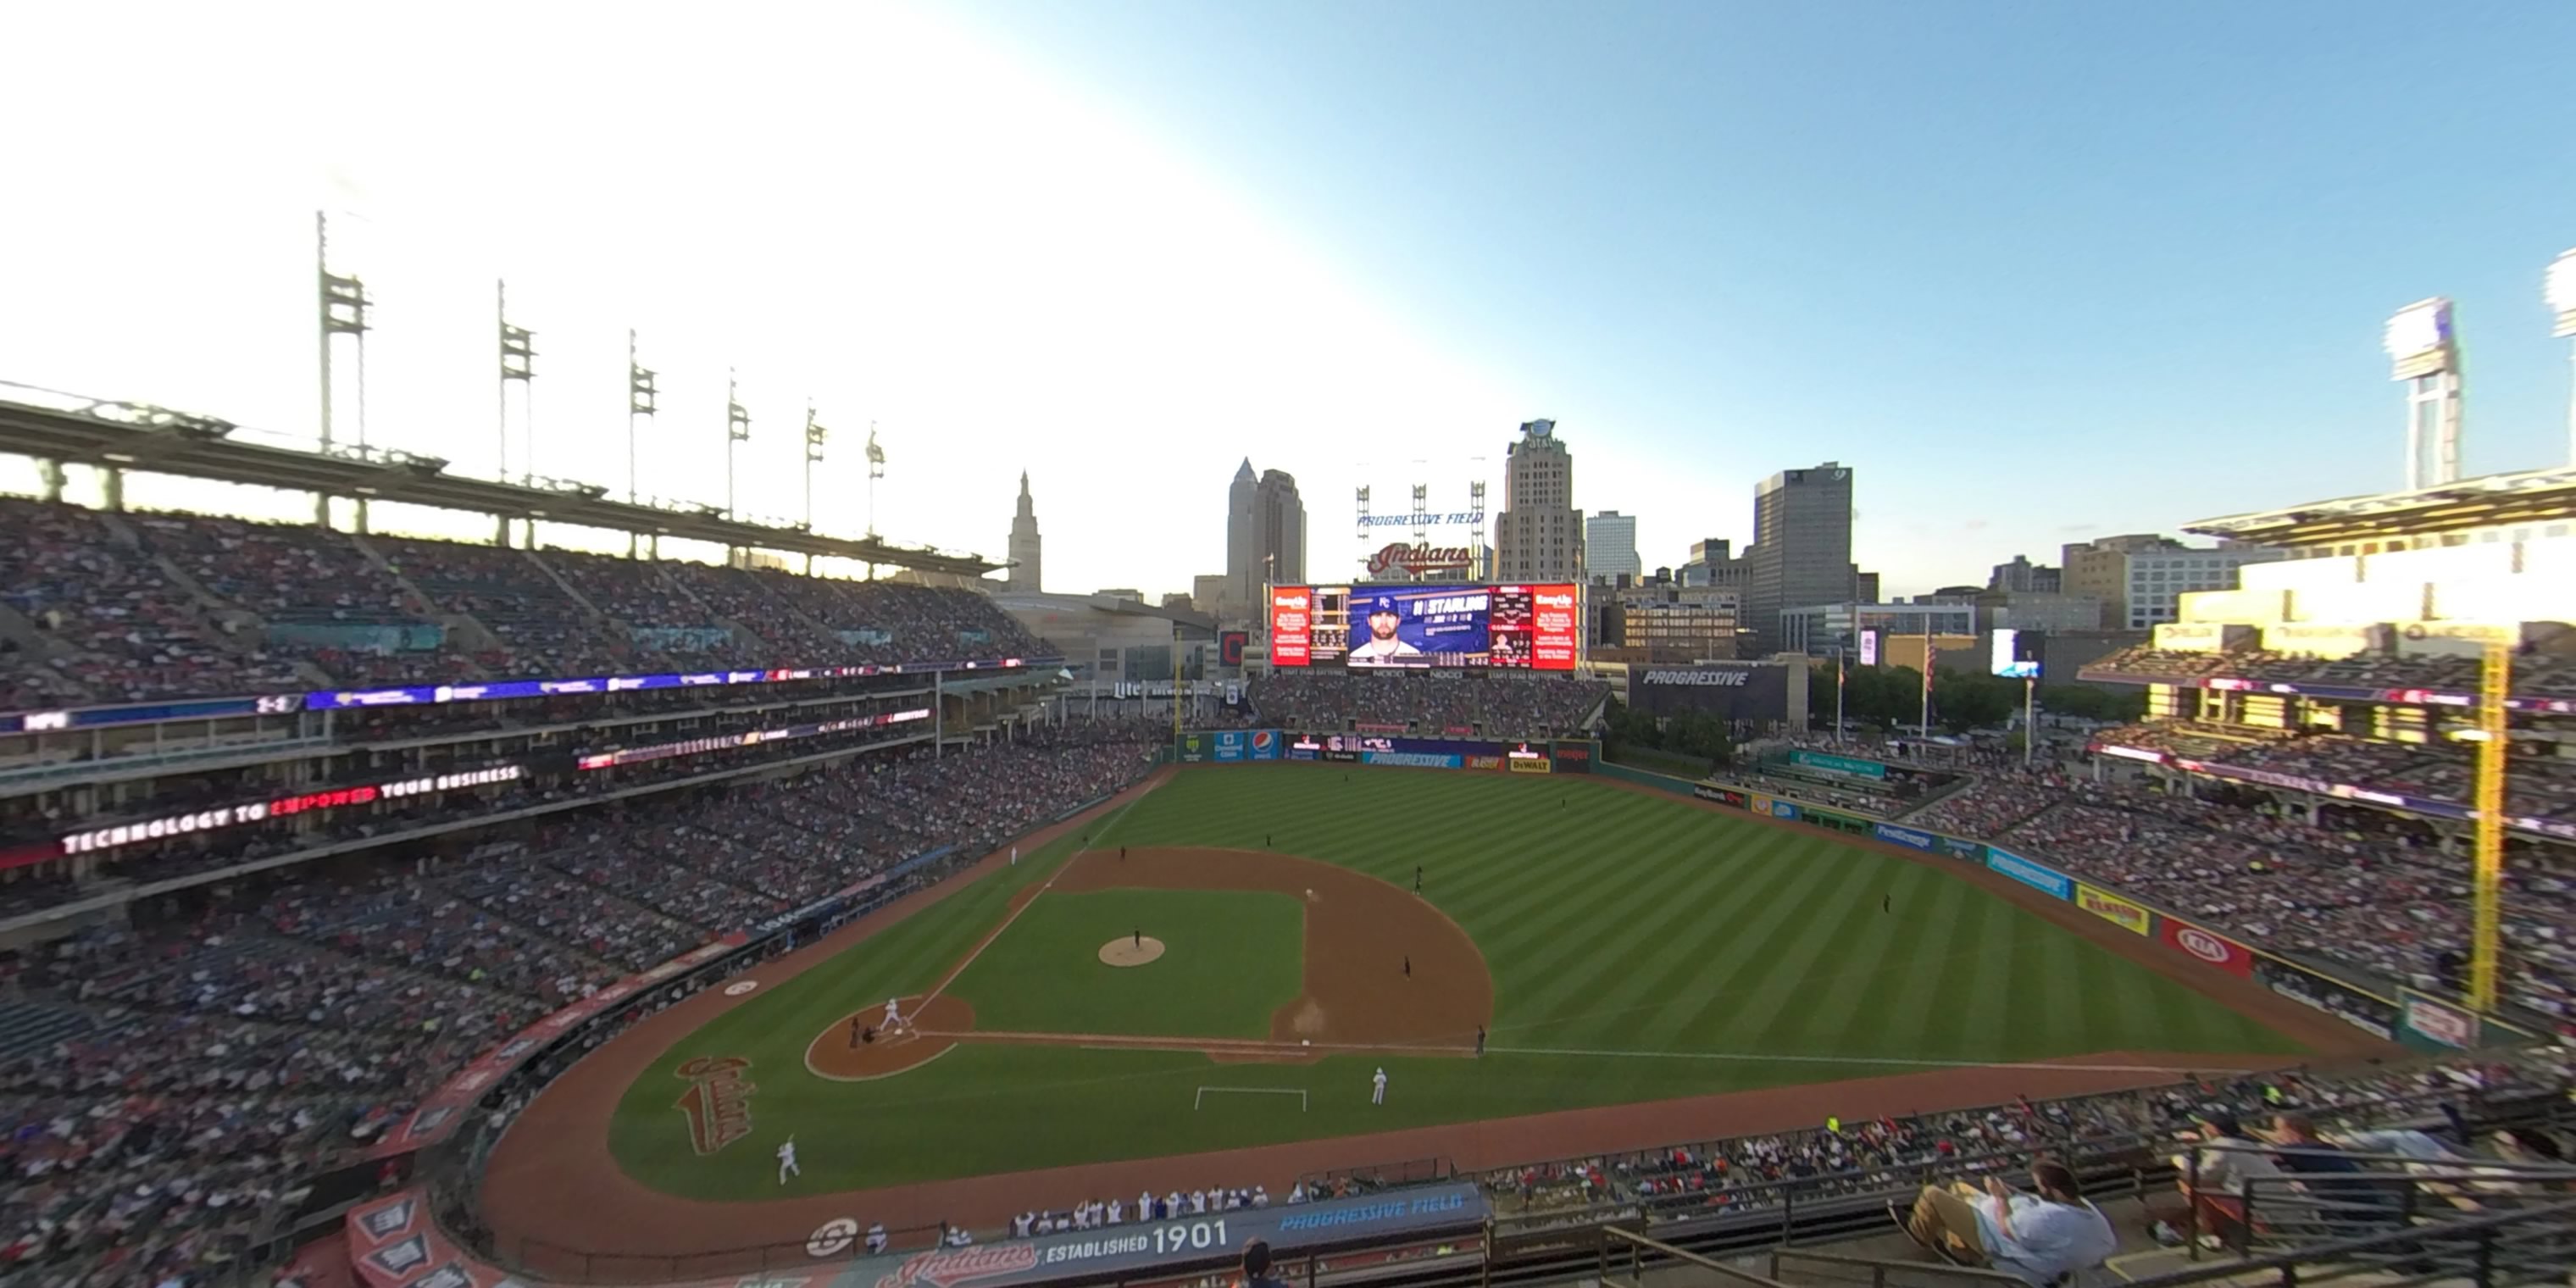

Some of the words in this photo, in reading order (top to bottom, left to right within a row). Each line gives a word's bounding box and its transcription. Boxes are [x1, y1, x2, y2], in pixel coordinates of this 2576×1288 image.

[1357, 514, 1443, 526] PROGRESSIVE
[1446, 512, 1484, 525] FIELD
[1368, 541, 1473, 575] Indians
[1428, 595, 1488, 614] STARLING
[1373, 669, 1405, 678] NOCO
[1430, 669, 1463, 679] NOCO
[1642, 669, 1749, 686] PROGRESSIVE
[1369, 752, 1451, 768] PROGRESSIVE
[62, 808, 230, 854] TECHNOLOGY
[236, 803, 267, 823] TO
[270, 786, 376, 816] EMPOWER
[382, 778, 432, 799] YOUR
[436, 765, 520, 791] BUSINESS
[2187, 934, 2220, 958] KIA
[1278, 1202, 1407, 1231] PROGRESSIVE
[1412, 1193, 1465, 1214] FIELD
[874, 1242, 1037, 1288] Indians
[1046, 1235, 1148, 1263] ESTABLISHED
[1152, 1219, 1227, 1254] 1901
